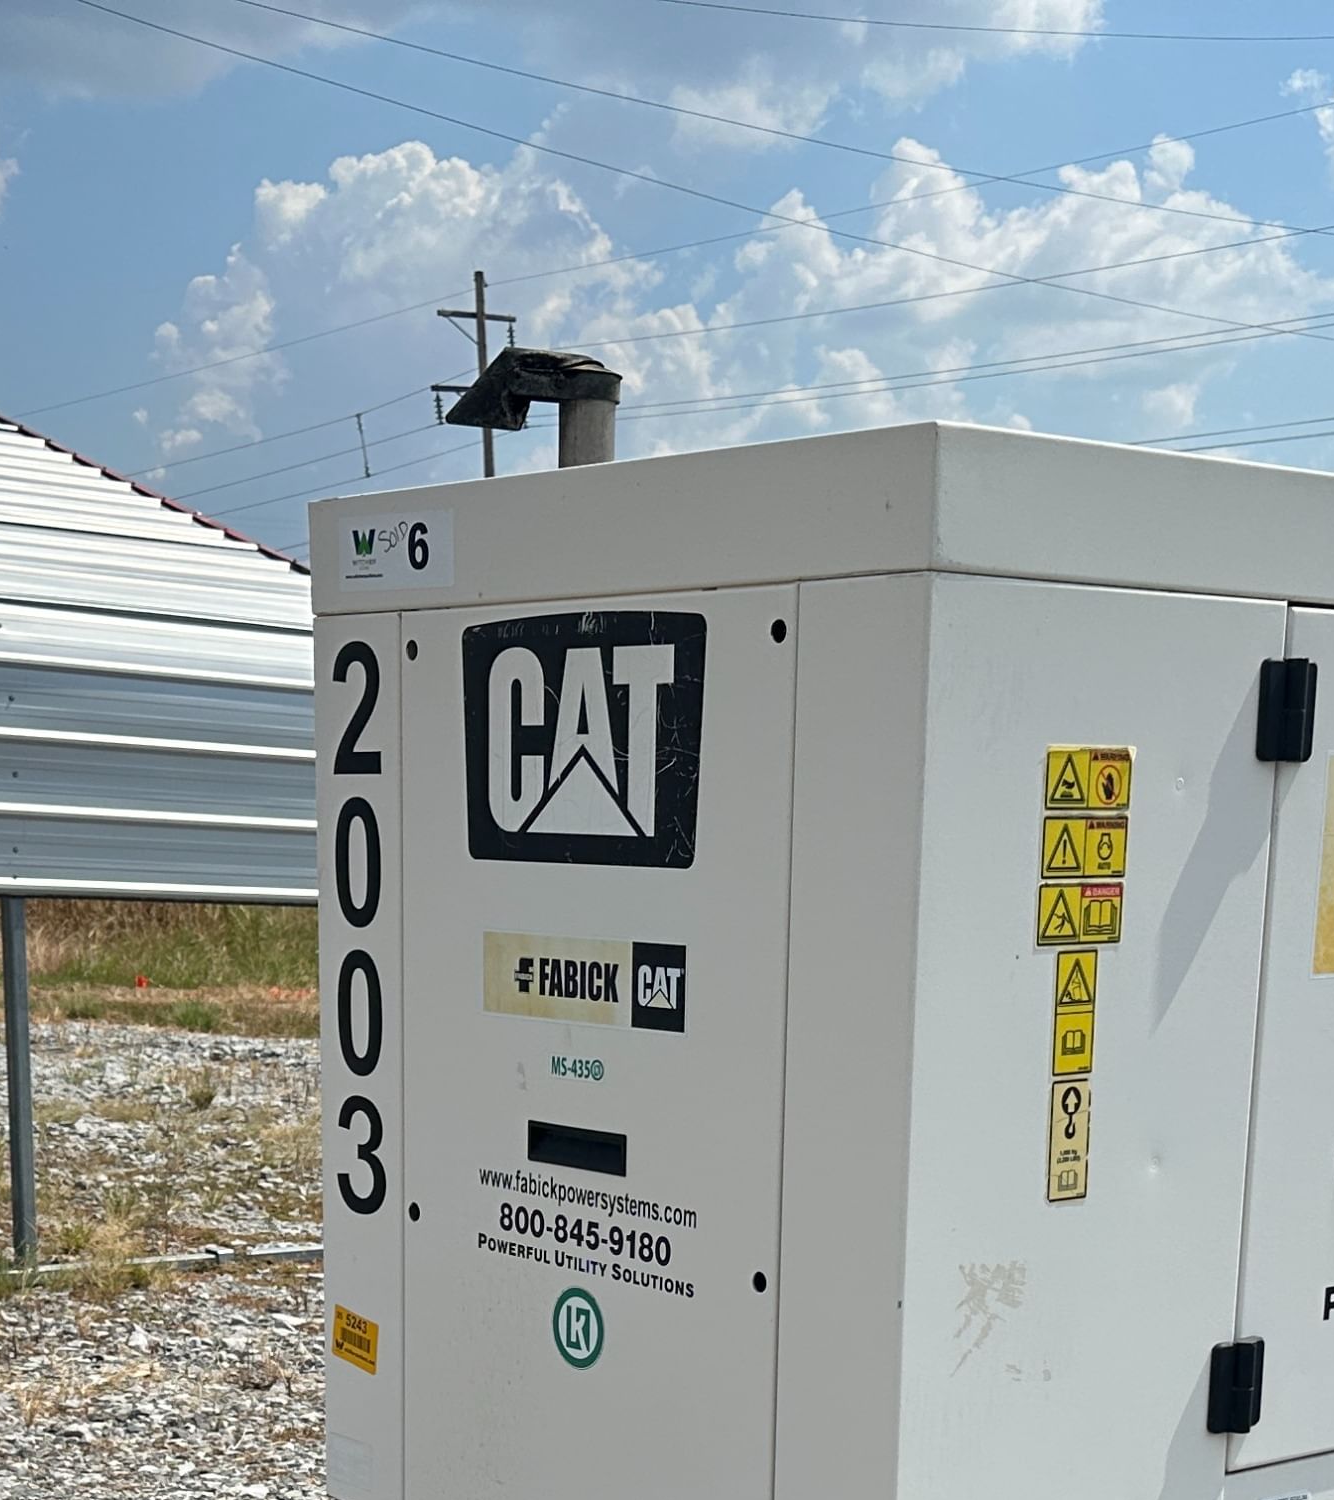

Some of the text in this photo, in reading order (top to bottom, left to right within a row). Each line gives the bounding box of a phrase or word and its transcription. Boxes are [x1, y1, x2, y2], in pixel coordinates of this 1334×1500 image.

[408, 522, 429, 570] 6
[488, 643, 676, 838] CAT
[538, 957, 620, 1003] FABICK
[637, 964, 682, 1010] CAT
[551, 1056, 591, 1079] MS-435
[479, 1168, 698, 1229] www.fabickpowersystems.com
[499, 1202, 672, 1267] 800-845-9180
[478, 1232, 695, 1298] POWERFUL UTILITY SOLUTIONS
[345, 1313, 368, 1335] 5243
